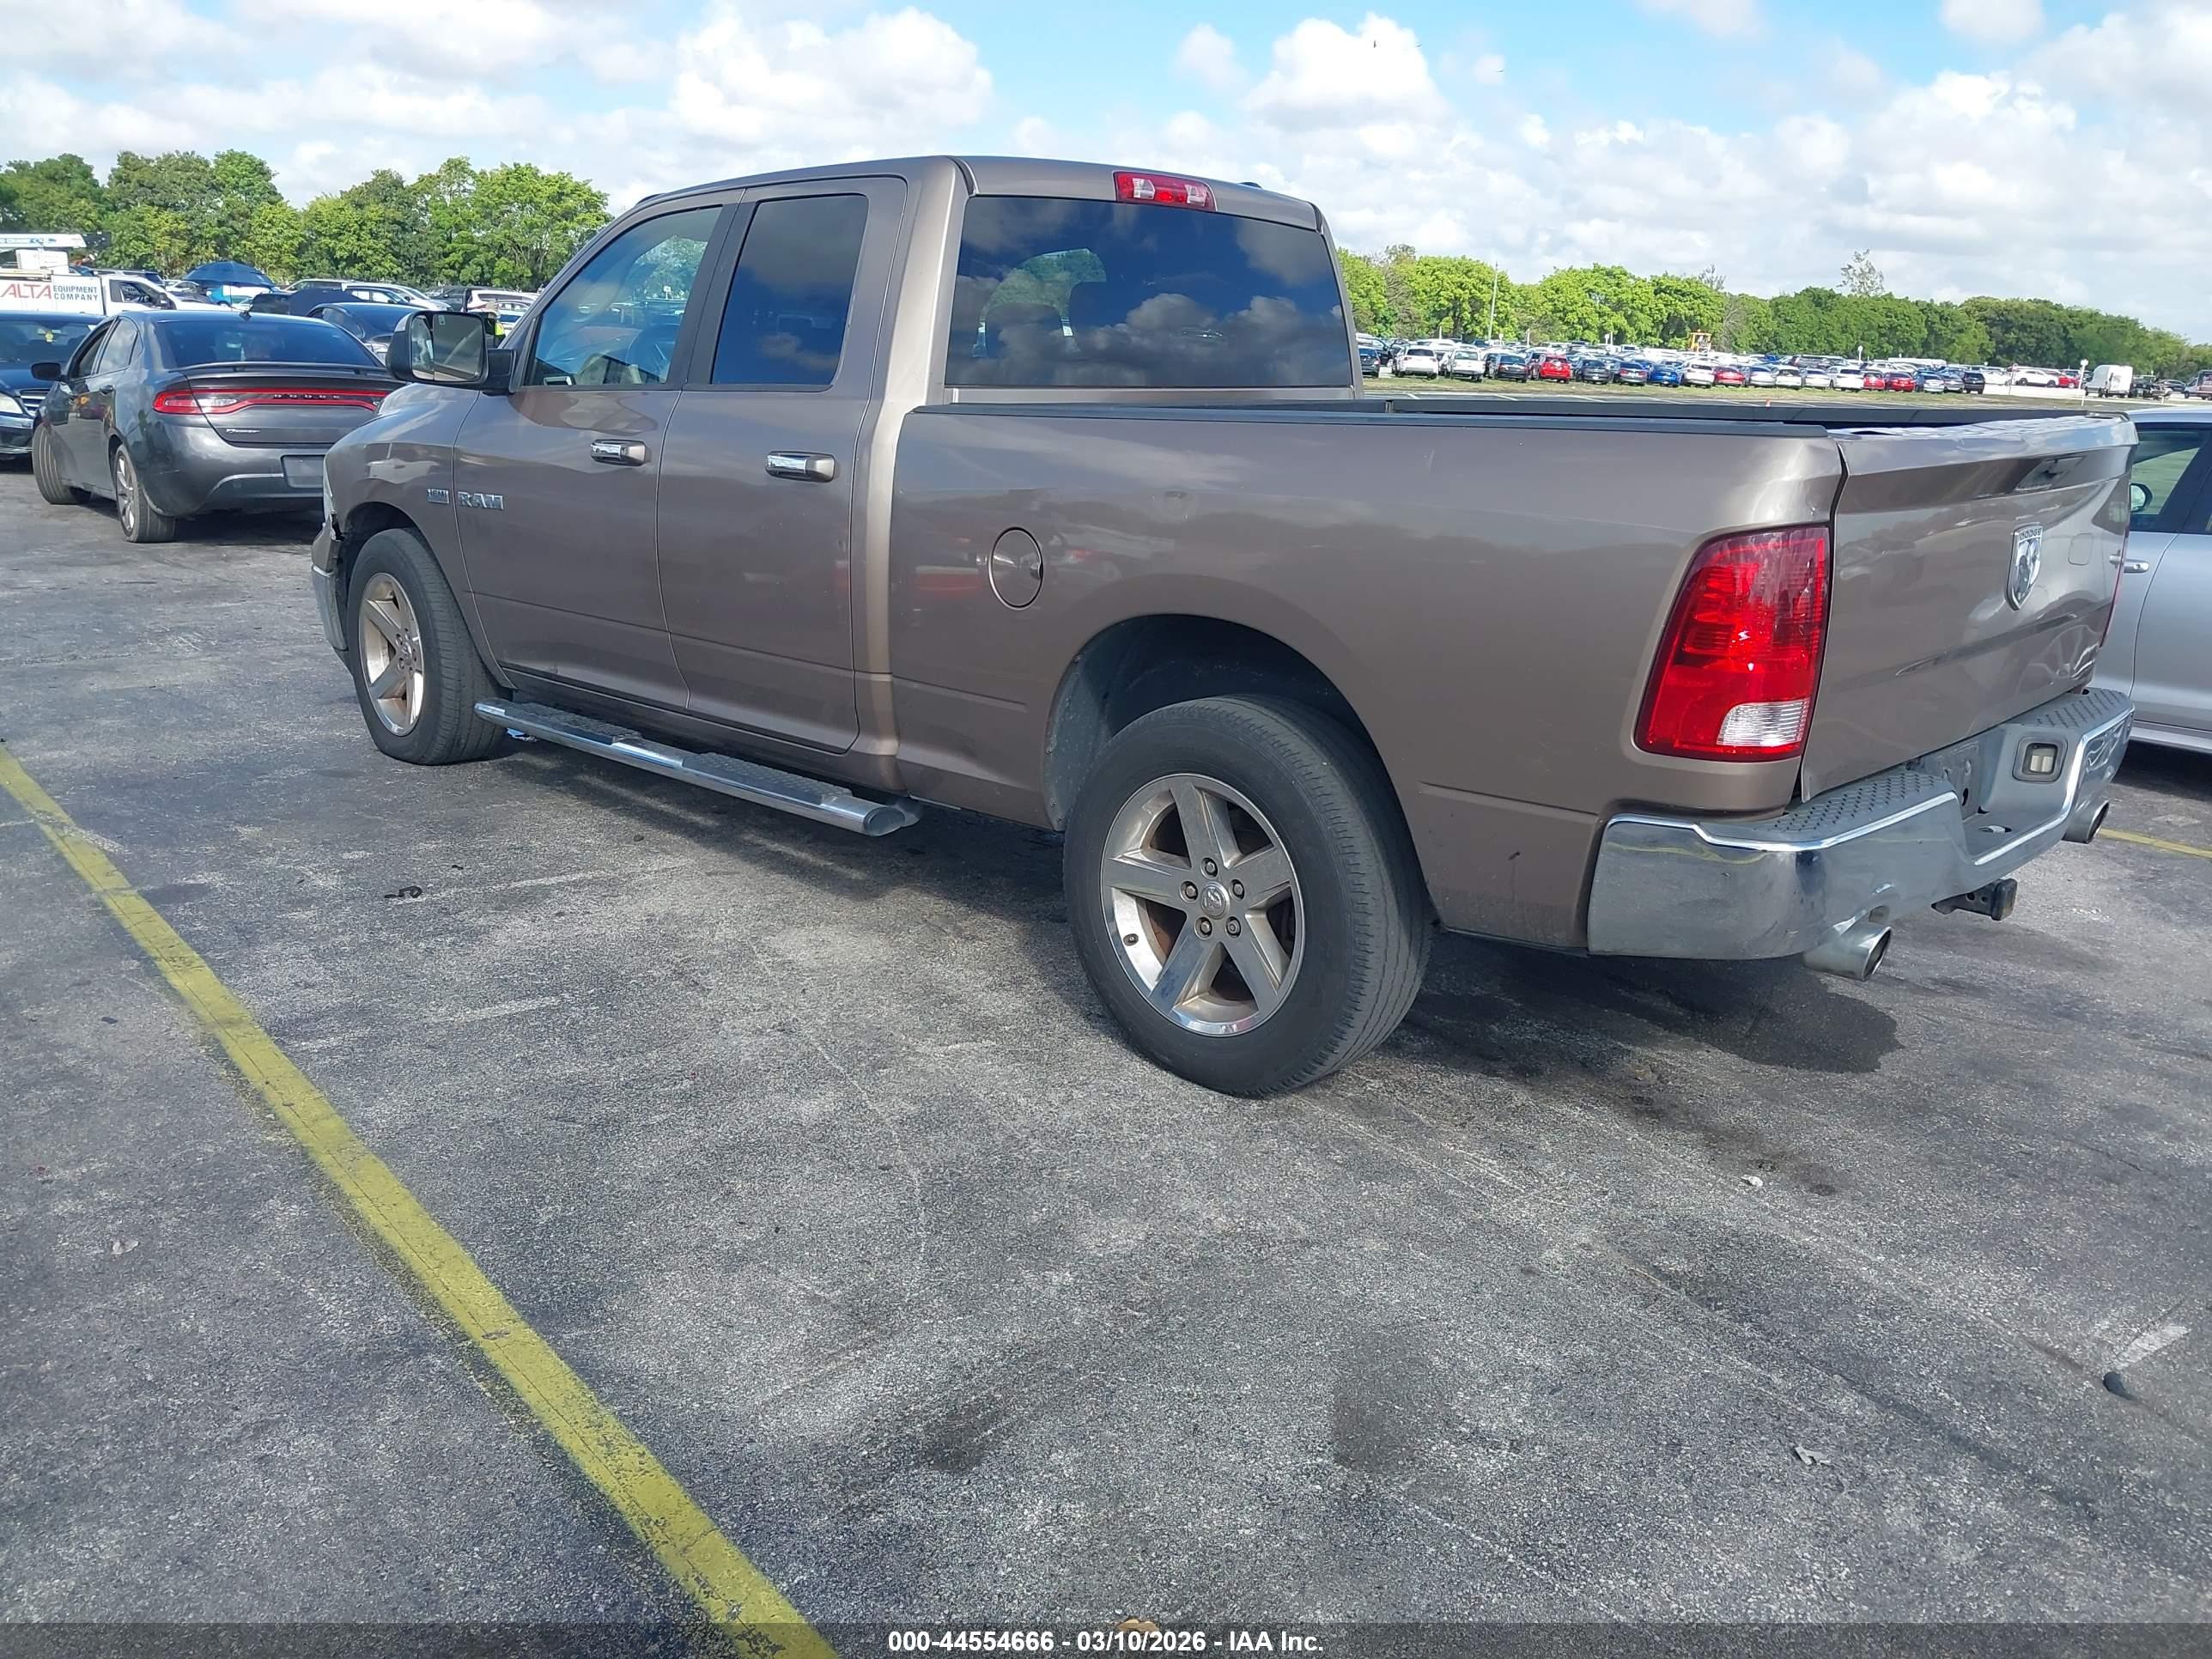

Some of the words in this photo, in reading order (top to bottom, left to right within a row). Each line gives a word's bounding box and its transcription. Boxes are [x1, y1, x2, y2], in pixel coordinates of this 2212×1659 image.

[0, 283, 52, 300] ALTA
[53, 284, 97, 293] EQUIPMENT
[53, 293, 99, 301] COMPANY
[458, 491, 503, 510] RAM
